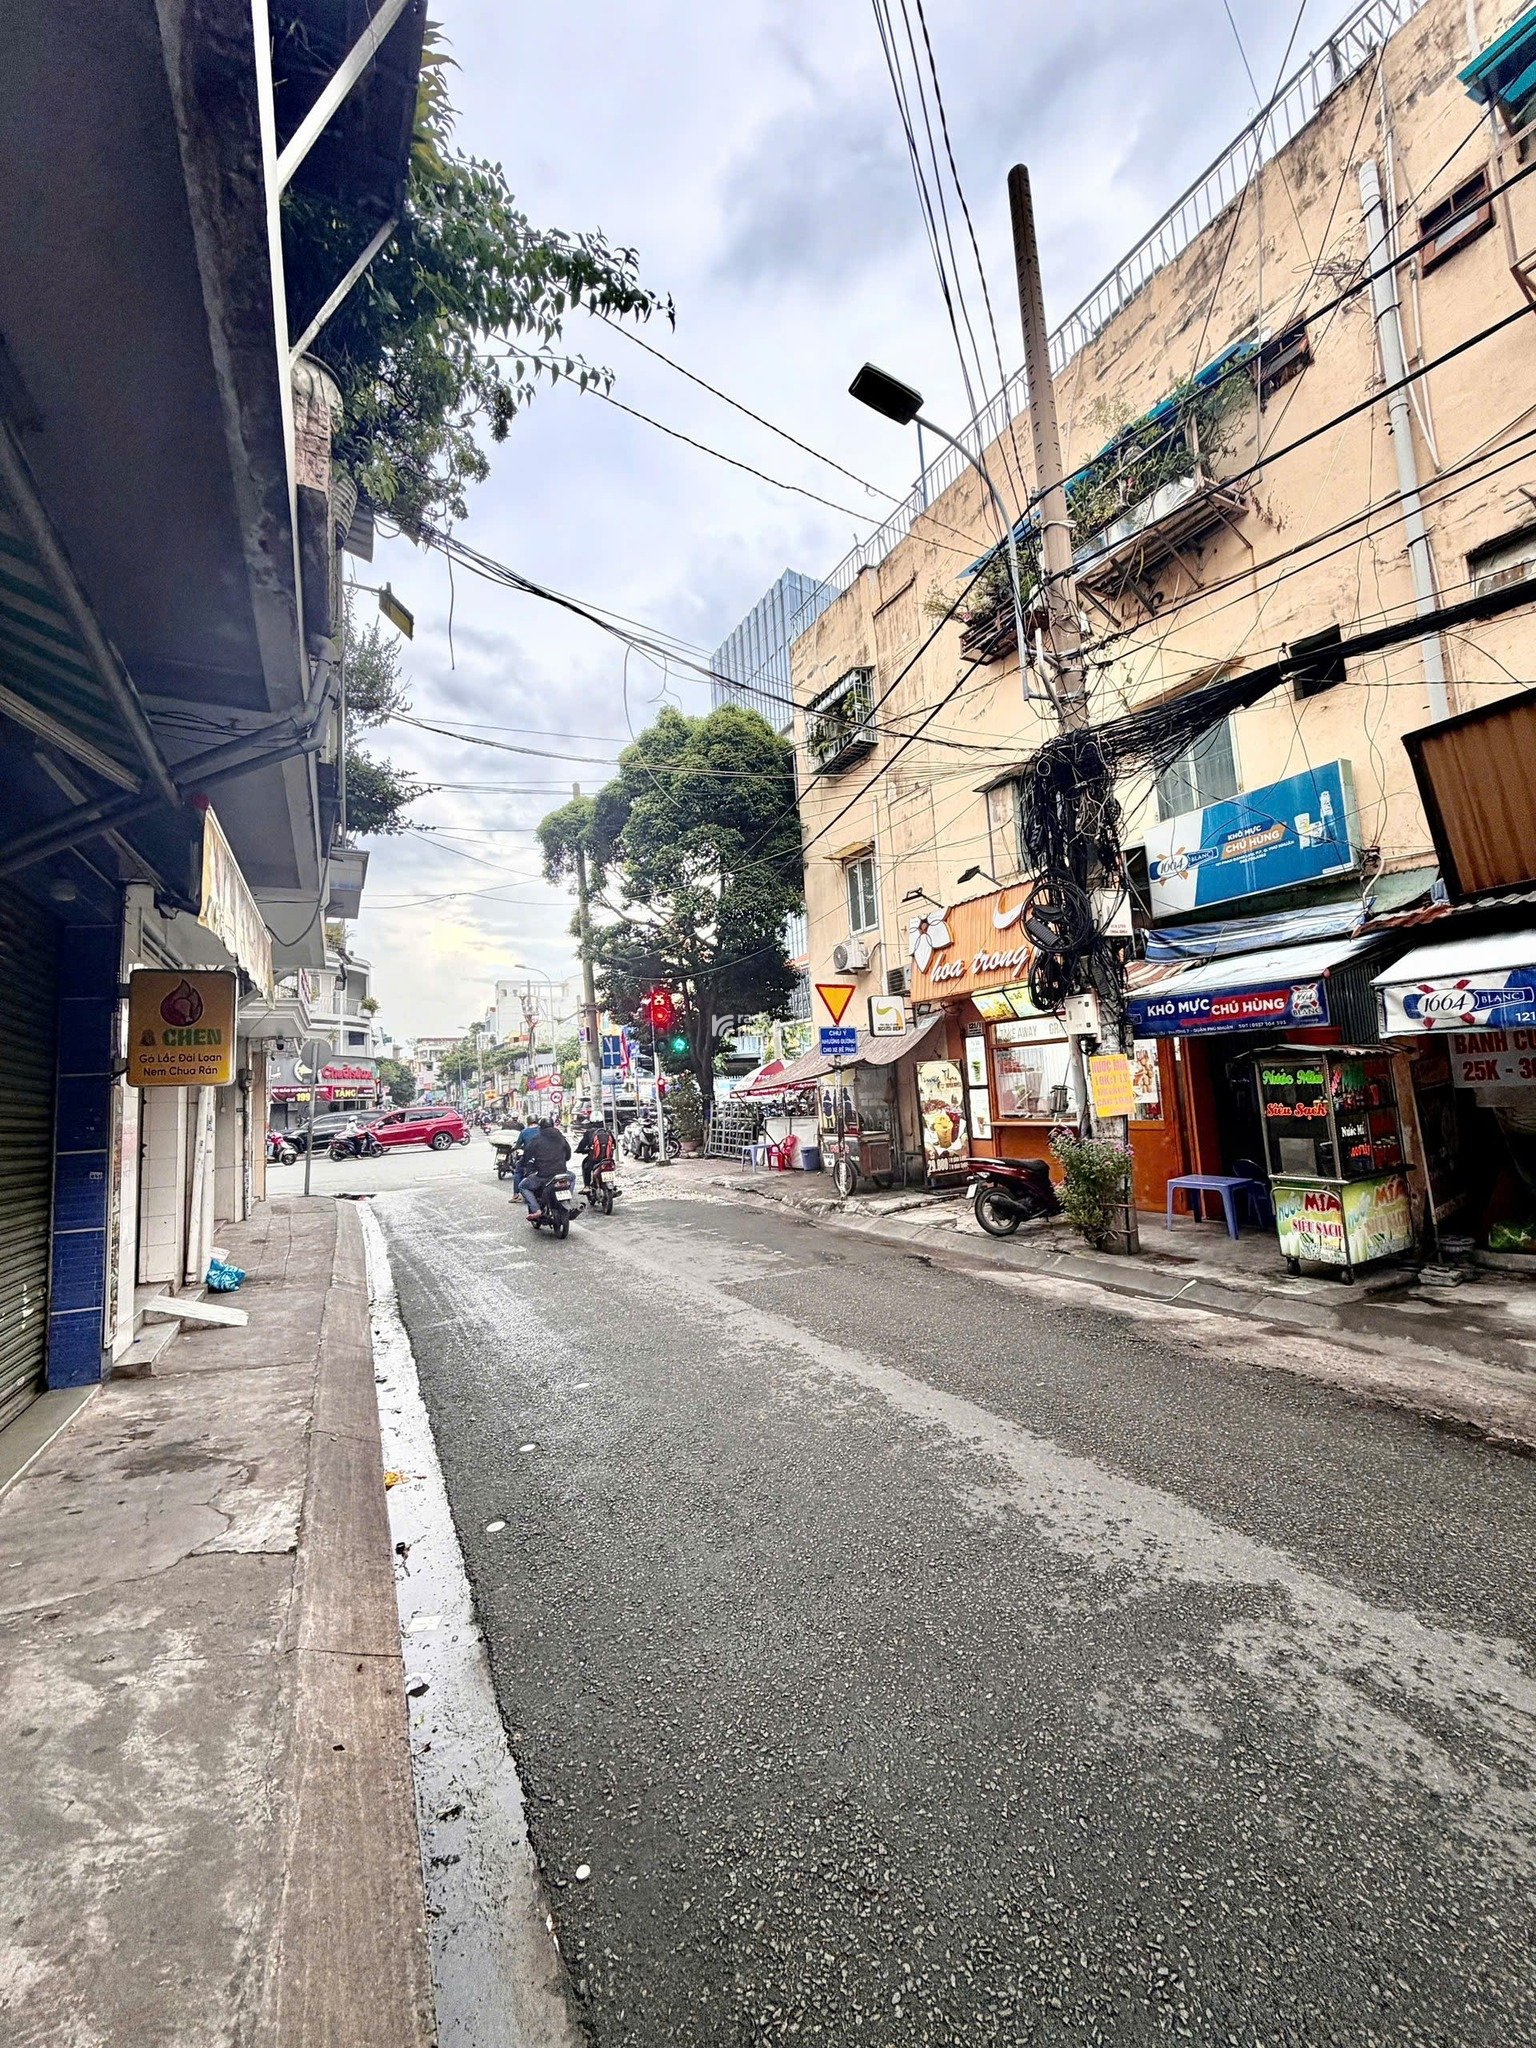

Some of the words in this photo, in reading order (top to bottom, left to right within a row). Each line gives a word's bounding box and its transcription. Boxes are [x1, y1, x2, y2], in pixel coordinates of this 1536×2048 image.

[1225, 838, 1247, 854] CHÚ
[1249, 830, 1280, 847] HÙNG
[1227, 831, 1243, 841] KHÔ
[1160, 858, 1185, 875] 1664
[1191, 851, 1213, 863] BLANC
[931, 951, 966, 982] hoa
[1147, 1001, 1175, 1017] KHÔ
[1178, 998, 1210, 1015] MỰC
[1211, 1002, 1239, 1015] CHÚ
[1243, 998, 1285, 1012] HÙNG
[1424, 993, 1468, 1012] 1664
[1481, 993, 1520, 1003] BLANC
[162, 1028, 222, 1047] CHEN
[1017, 1025, 1038, 1039] AWAY
[198, 1053, 222, 1062] Loan
[143, 1067, 166, 1076] Nem
[168, 1066, 196, 1075] Chua
[1462, 1059, 1501, 1082] 25K
[334, 1087, 356, 1099] TẶNG
[1293, 1102, 1328, 1121] Sạch
